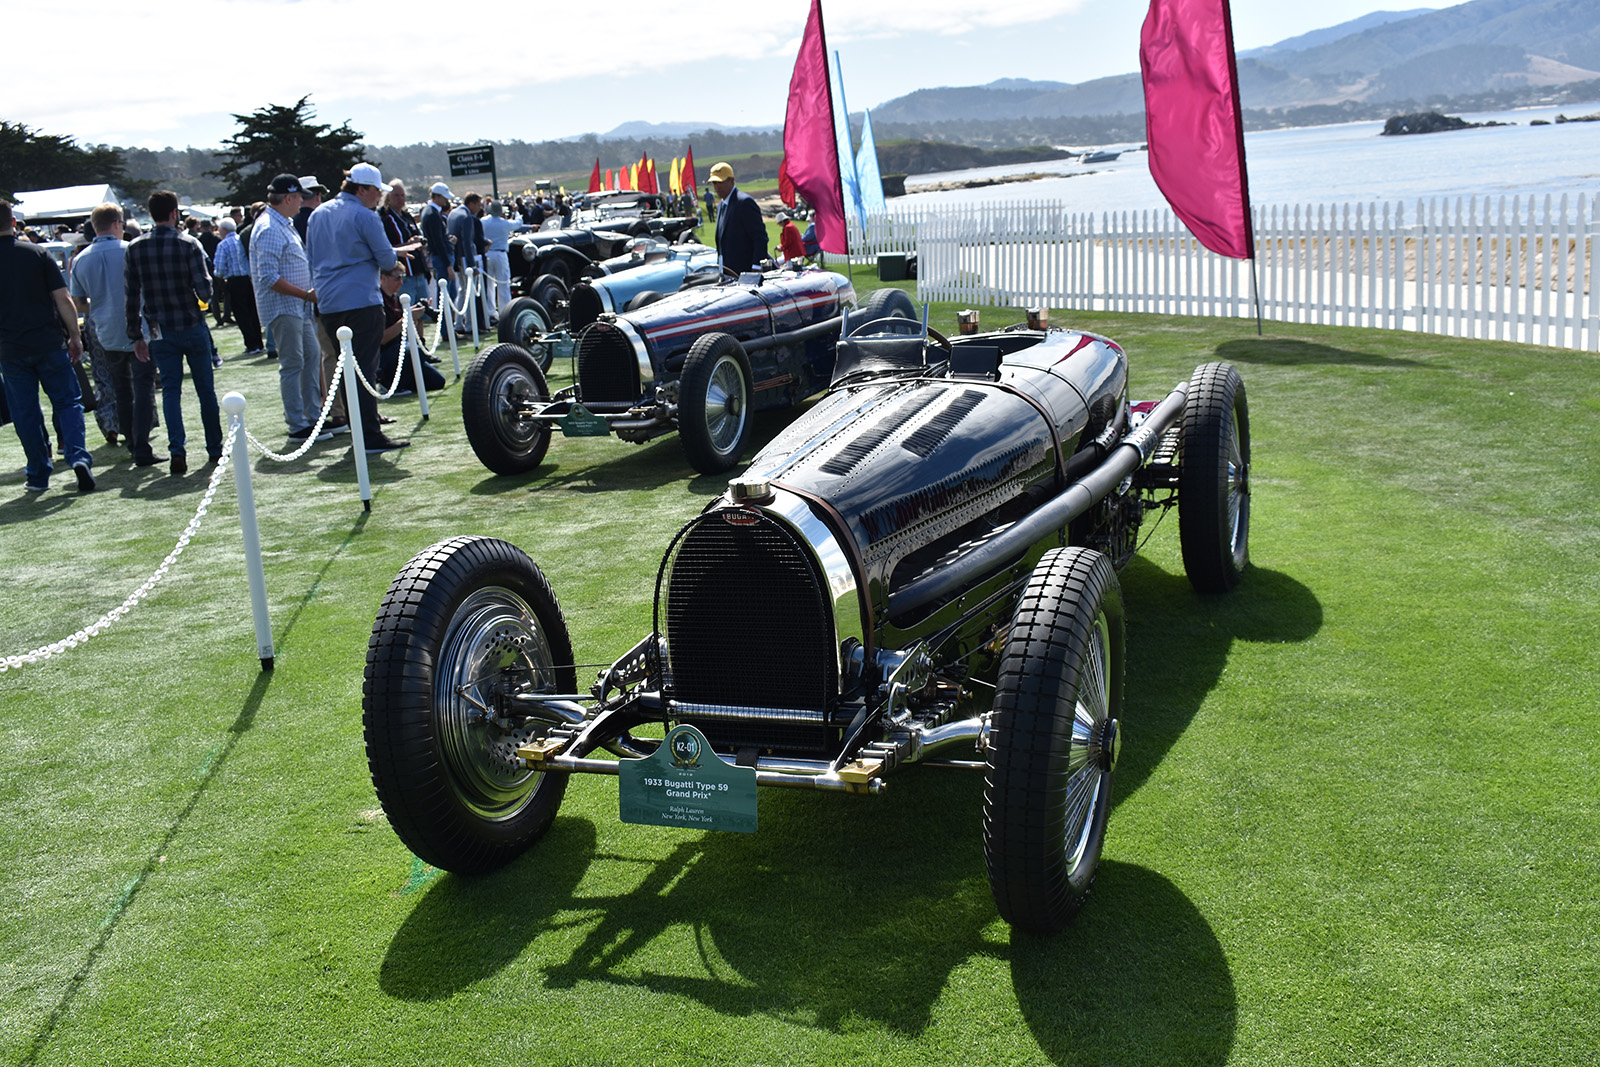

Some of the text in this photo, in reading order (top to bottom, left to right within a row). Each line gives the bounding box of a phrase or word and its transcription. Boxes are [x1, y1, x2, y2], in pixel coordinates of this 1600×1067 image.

[676, 741, 694, 752] K2-01
[644, 778, 729, 791] 1933 Bugatti Type 59
[666, 789, 690, 798] Grand
[669, 805, 684, 814] Ralph
[674, 813, 687, 821] York,
